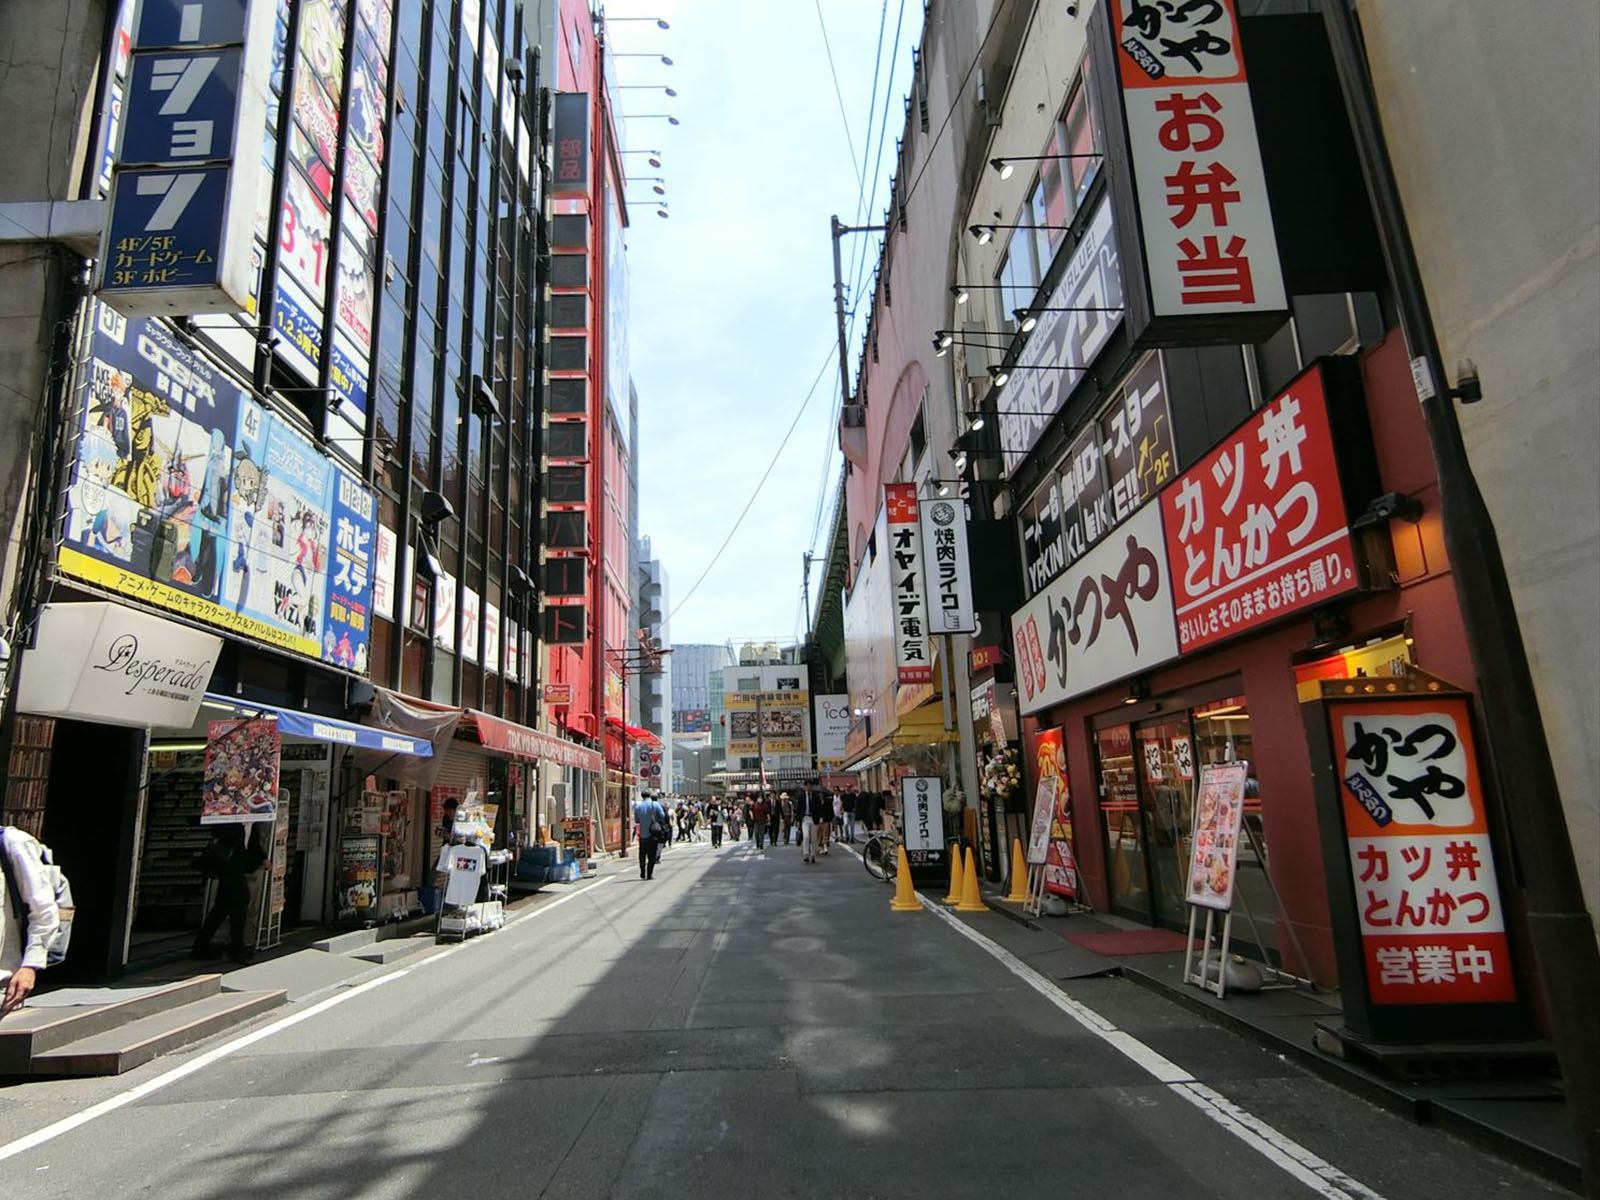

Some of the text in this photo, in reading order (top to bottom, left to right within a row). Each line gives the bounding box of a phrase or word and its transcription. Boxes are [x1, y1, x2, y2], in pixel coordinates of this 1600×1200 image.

[1155, 92, 1256, 304] お弁当
[112, 269, 193, 284] 3F ホビー
[115, 249, 213, 269] カードゲーム
[116, 236, 177, 252] 4F/5F
[1061, 232, 1097, 300] VALUE!
[1154, 451, 1170, 486] 2F
[1176, 393, 1308, 544] カツ丼
[934, 529, 960, 610] 焼肉ライク
[1184, 481, 1321, 597] とんかつ
[893, 528, 925, 661] オヤイデ電気
[1047, 535, 1159, 690] かつや
[1180, 553, 1352, 645] おいしさそのままお持ち帰り。
[93, 633, 211, 696] Desperado
[1345, 721, 1466, 820] かつや
[917, 793, 930, 839] 焼肉ライク
[1358, 839, 1482, 883] カツ丼
[1364, 885, 1492, 930] とんかつ
[1376, 944, 1495, 988] 営業中
